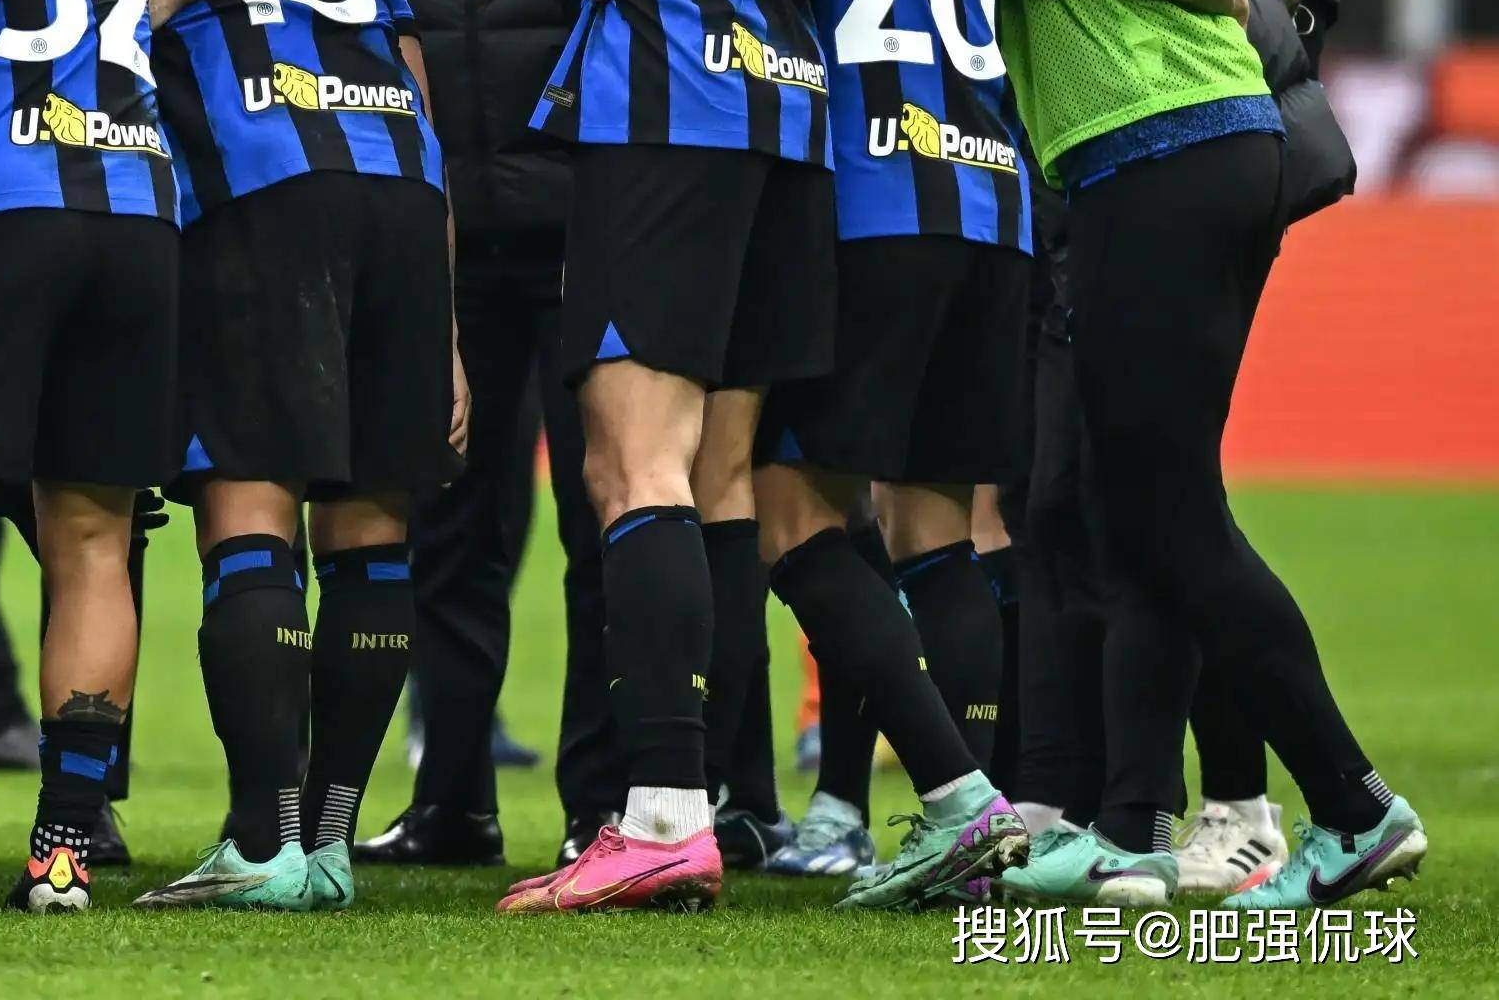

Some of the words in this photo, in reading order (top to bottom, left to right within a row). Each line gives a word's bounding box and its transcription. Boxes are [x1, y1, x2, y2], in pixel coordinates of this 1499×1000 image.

[318, 76, 412, 110] Power
[940, 124, 1016, 168] Power
[351, 632, 409, 650] INTER
